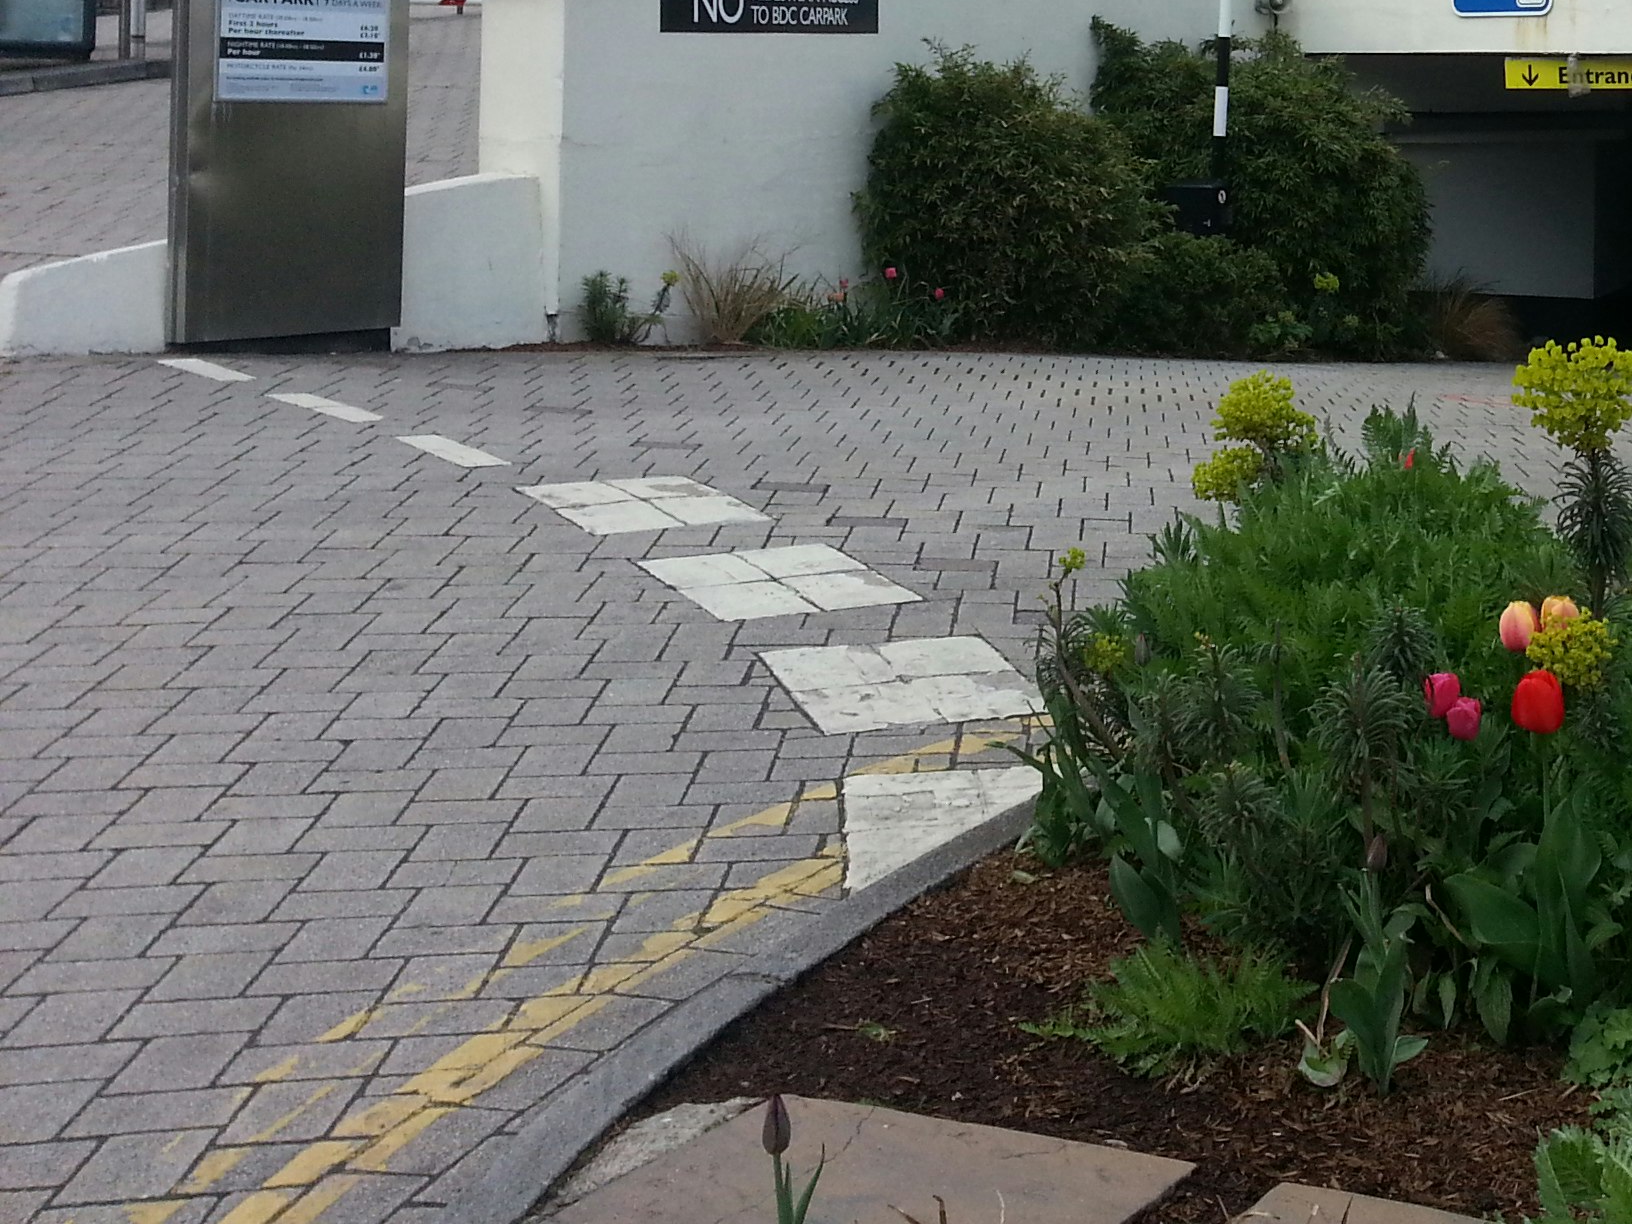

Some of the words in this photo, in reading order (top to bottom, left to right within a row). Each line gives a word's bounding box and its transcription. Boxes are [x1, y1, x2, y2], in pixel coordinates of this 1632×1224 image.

[751, 6, 769, 24] TO
[772, 6, 797, 24] BDC
[800, 7, 848, 26] CARPARK
